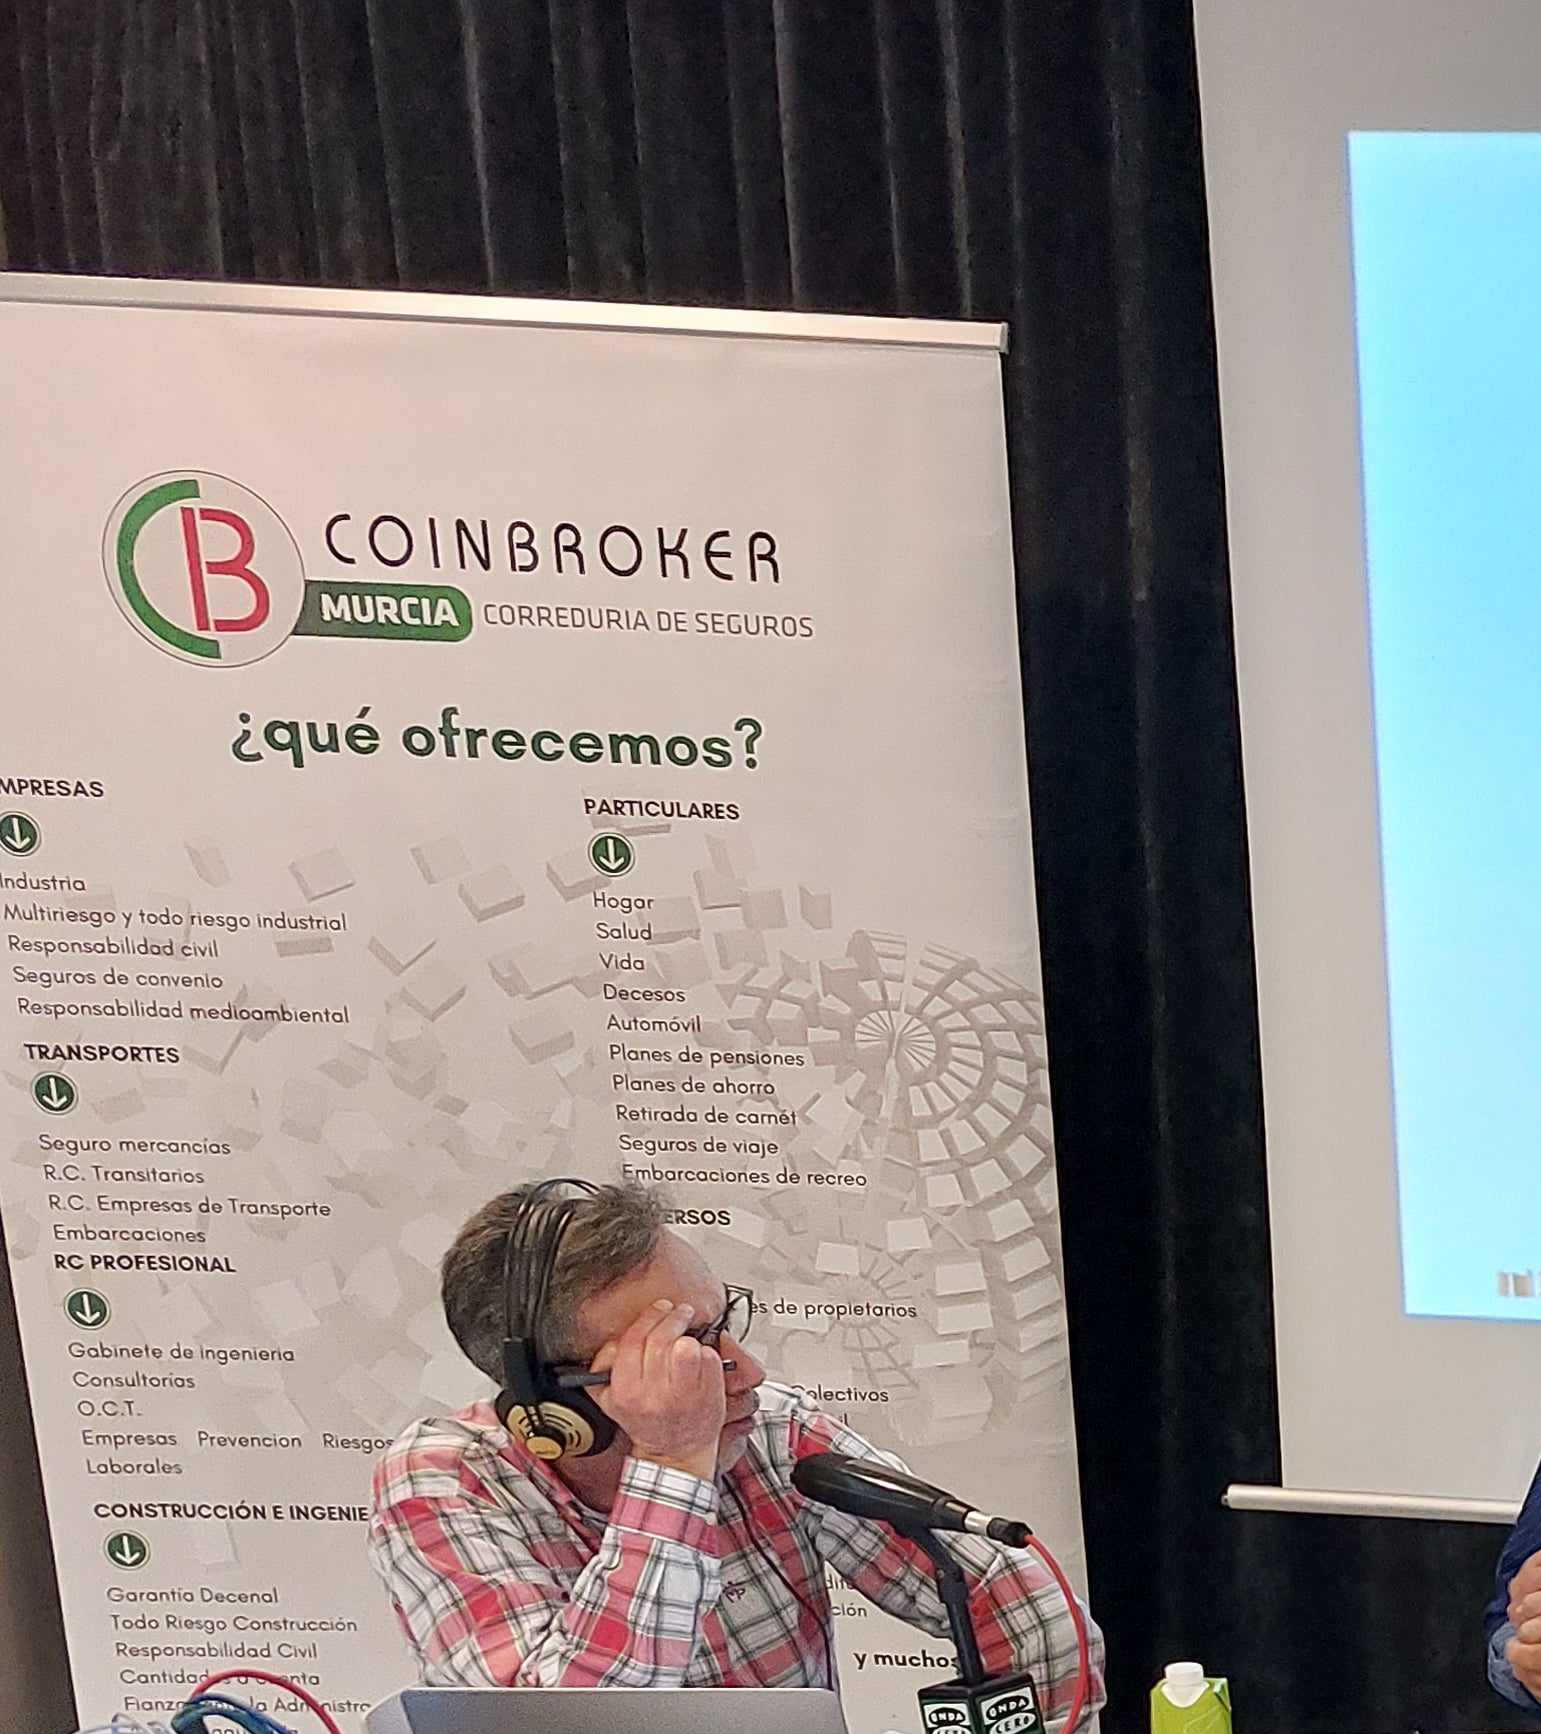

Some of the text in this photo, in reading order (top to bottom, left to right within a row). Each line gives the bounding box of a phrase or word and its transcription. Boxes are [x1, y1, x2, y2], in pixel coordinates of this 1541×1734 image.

[325, 514, 781, 583] COINBROKER
[321, 594, 460, 627] MURCIA
[483, 604, 814, 637] CORREDURIA DE SEGUROS
[231, 706, 764, 770] ¿qué ofrecemos?
[584, 798, 740, 820] PARTICULARES
[594, 892, 654, 913] Hogar
[3, 904, 347, 932] Multiriesgo y todo riesgo industrial
[596, 923, 652, 940] Salud
[8, 935, 219, 957] Responsabilidad civil
[599, 953, 645, 971] Vida
[13, 967, 223, 988] Seguros de convenio
[604, 984, 686, 1003] Decesos
[18, 997, 349, 1024] Responsabilidad medioambiental
[607, 1015, 701, 1033] Automóvil
[24, 1044, 180, 1063] TRANSPORTES
[609, 1044, 805, 1067] Planes de pensiones
[613, 1075, 775, 1095] Planes de ahorro
[616, 1105, 698, 1122] Retirada
[705, 1107, 728, 1124] de
[39, 1134, 112, 1155] Seguro
[619, 1135, 779, 1159] Seguros de viaje
[44, 1165, 205, 1184] R.C. Transitarios
[622, 1163, 867, 1187] Embarcaciones de recreo
[49, 1195, 331, 1219] R.C. Empresas de Transporte
[53, 1224, 206, 1243] Embarcaciones
[54, 1255, 237, 1273] RC PROFESIONAL
[774, 1299, 797, 1315] de
[805, 1302, 917, 1320] propietarios
[68, 1342, 163, 1360] Gabinete
[170, 1343, 194, 1360] de
[78, 1401, 142, 1417] O.C.T.
[82, 1430, 178, 1450] Empresas
[87, 1458, 183, 1475] Laborales
[94, 1500, 266, 1521] CONSTRUCCIÓN
[274, 1505, 284, 1521] E
[200, 1587, 279, 1604] Decenal
[111, 1614, 357, 1634] Todo Riesgo Construcción
[116, 1643, 317, 1662] Responsabilidad Civil
[853, 1652, 867, 1670] y
[989, 1698, 1026, 1717] ONDA
[996, 1715, 1029, 1734] CERO
